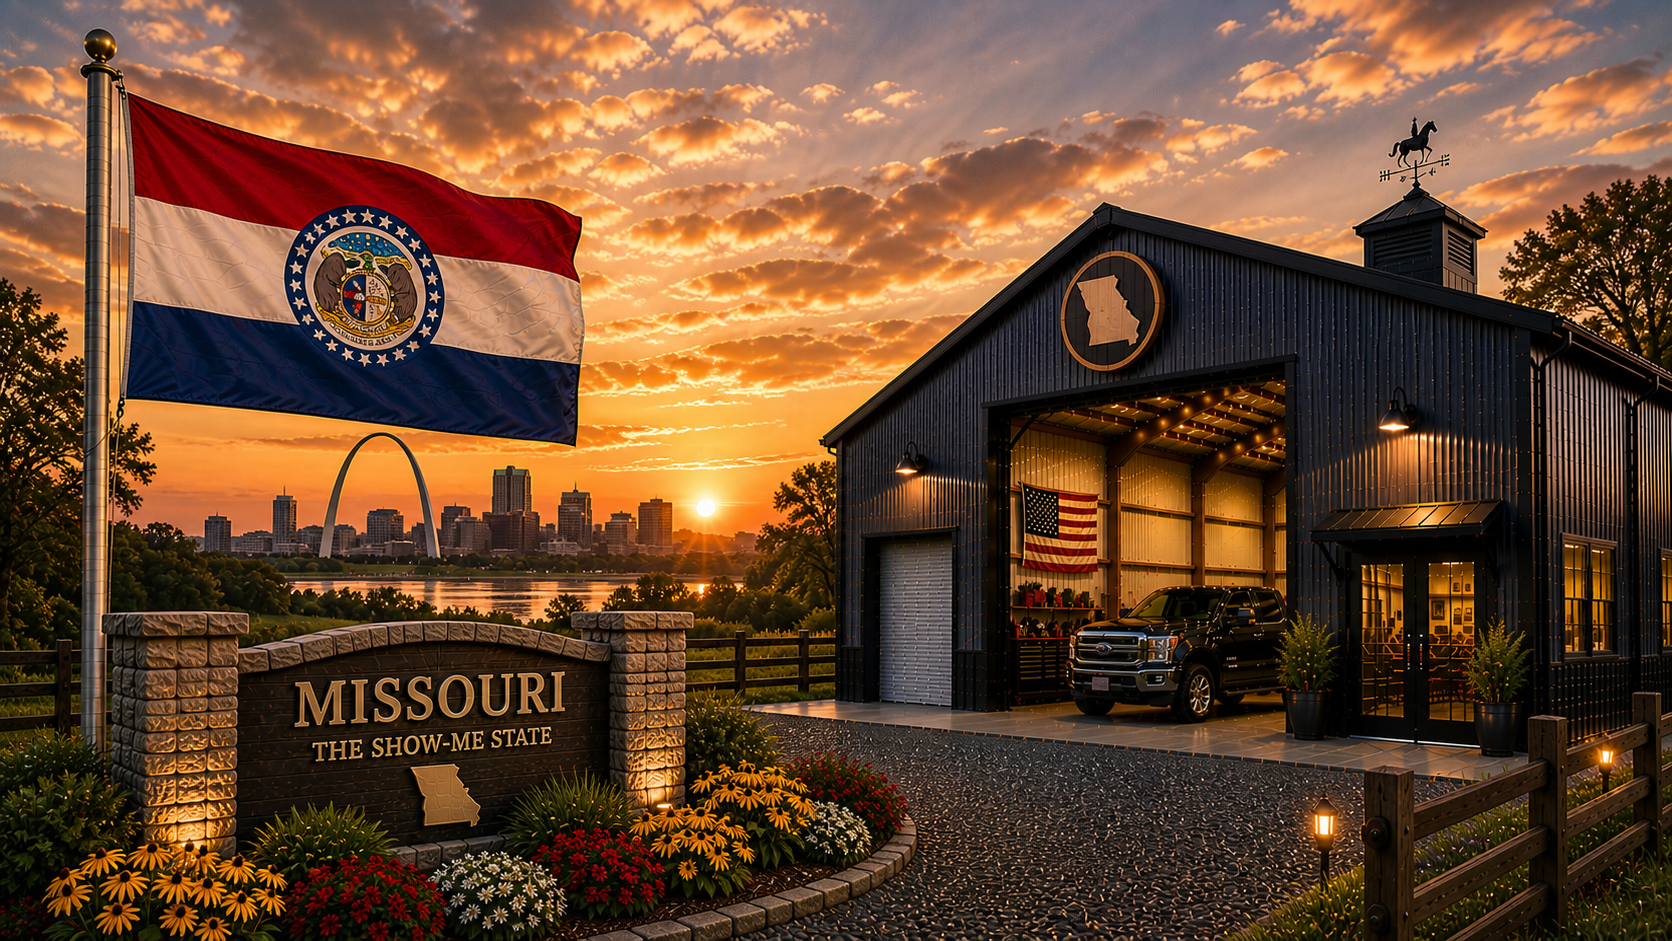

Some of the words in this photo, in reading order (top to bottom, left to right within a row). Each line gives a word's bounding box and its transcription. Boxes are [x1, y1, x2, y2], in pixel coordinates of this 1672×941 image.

[293, 671, 566, 728] MISSOURI
[312, 739, 364, 762] THE
[371, 730, 485, 759] SHOW-ME
[490, 726, 553, 749] STATE
